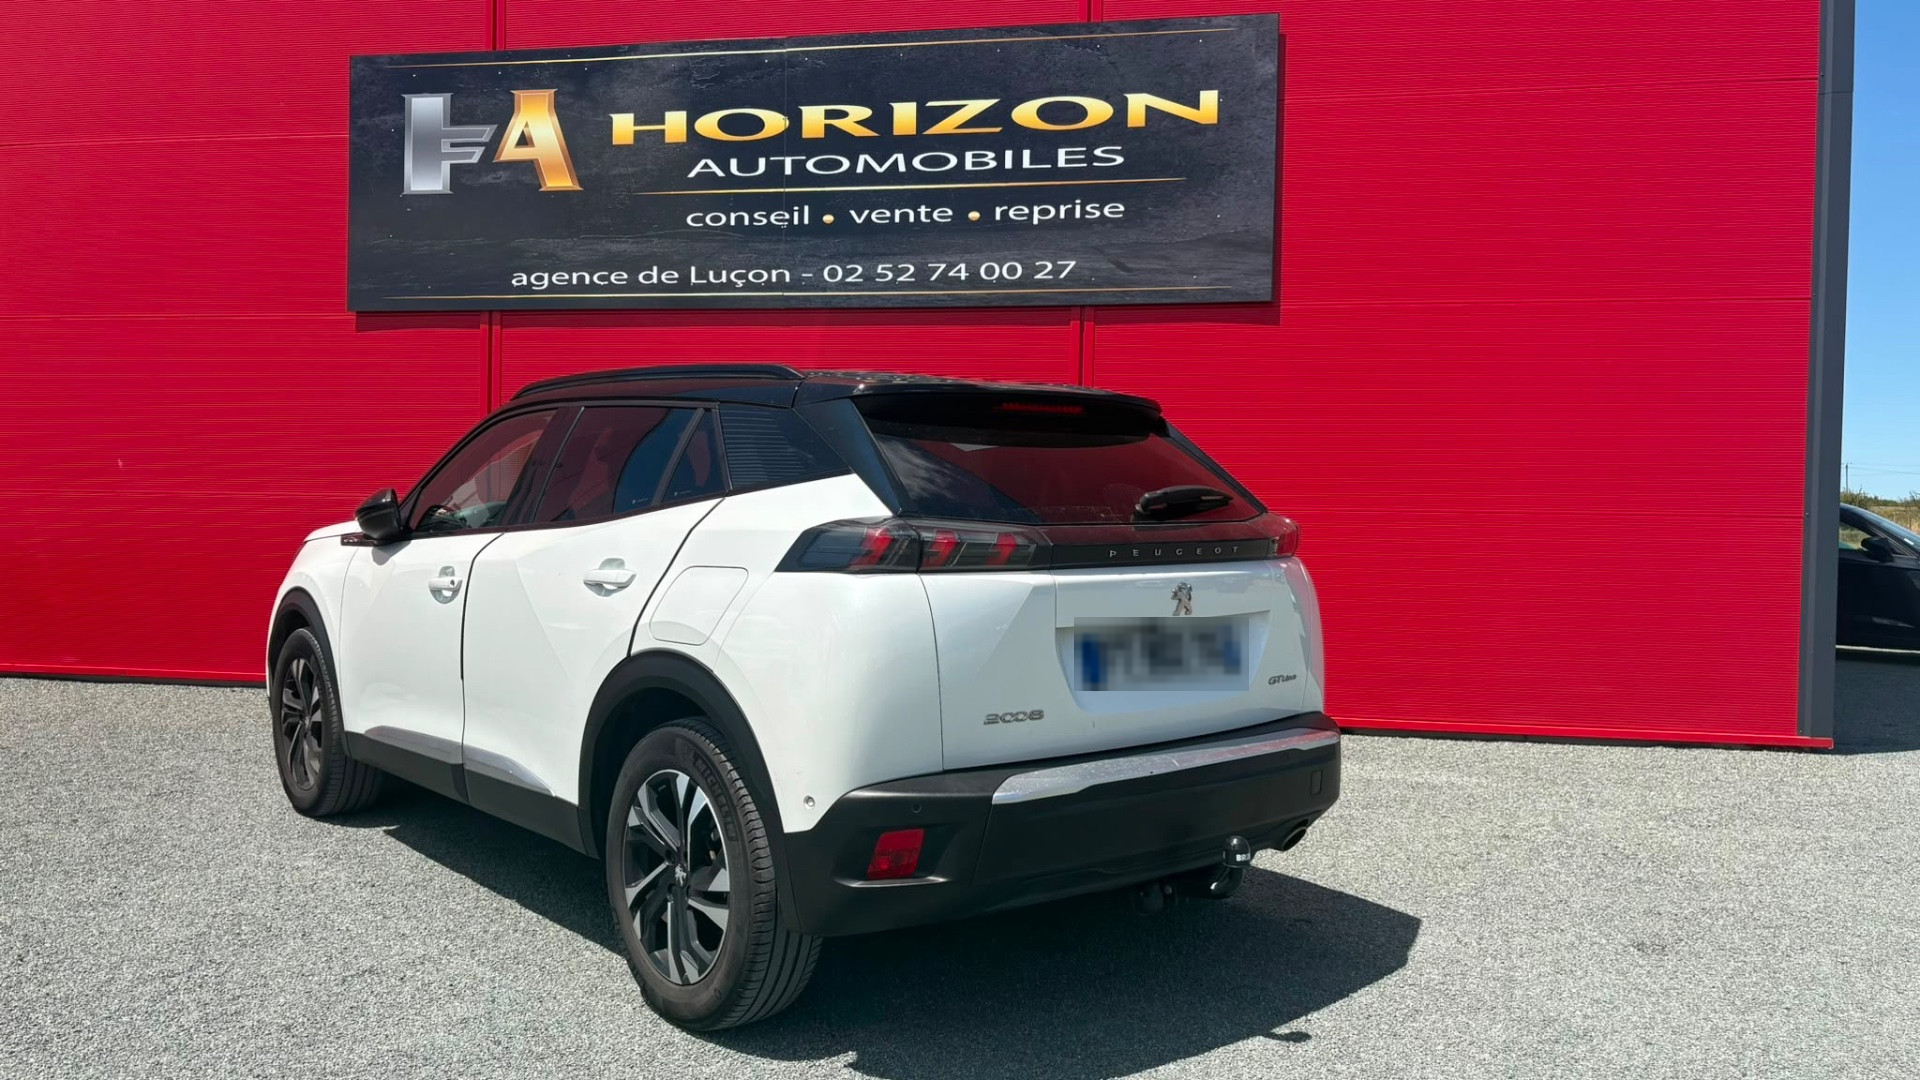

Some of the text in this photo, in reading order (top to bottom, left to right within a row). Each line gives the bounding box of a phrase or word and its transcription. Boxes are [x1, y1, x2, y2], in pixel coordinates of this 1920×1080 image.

[609, 89, 1219, 146] HORIZON
[686, 145, 1126, 179] AUTOMOBILES
[686, 199, 1125, 228] conseil vente reprise
[511, 271, 629, 290] agence
[638, 265, 680, 285] de
[690, 265, 791, 288] Luçon
[822, 264, 864, 283] 02
[875, 263, 917, 283] 52
[927, 262, 970, 281] 74
[979, 261, 1023, 281] 00
[1033, 260, 1077, 280] 27
[1109, 546, 1238, 558] PEUGEOT
[983, 709, 1045, 726] 2008
